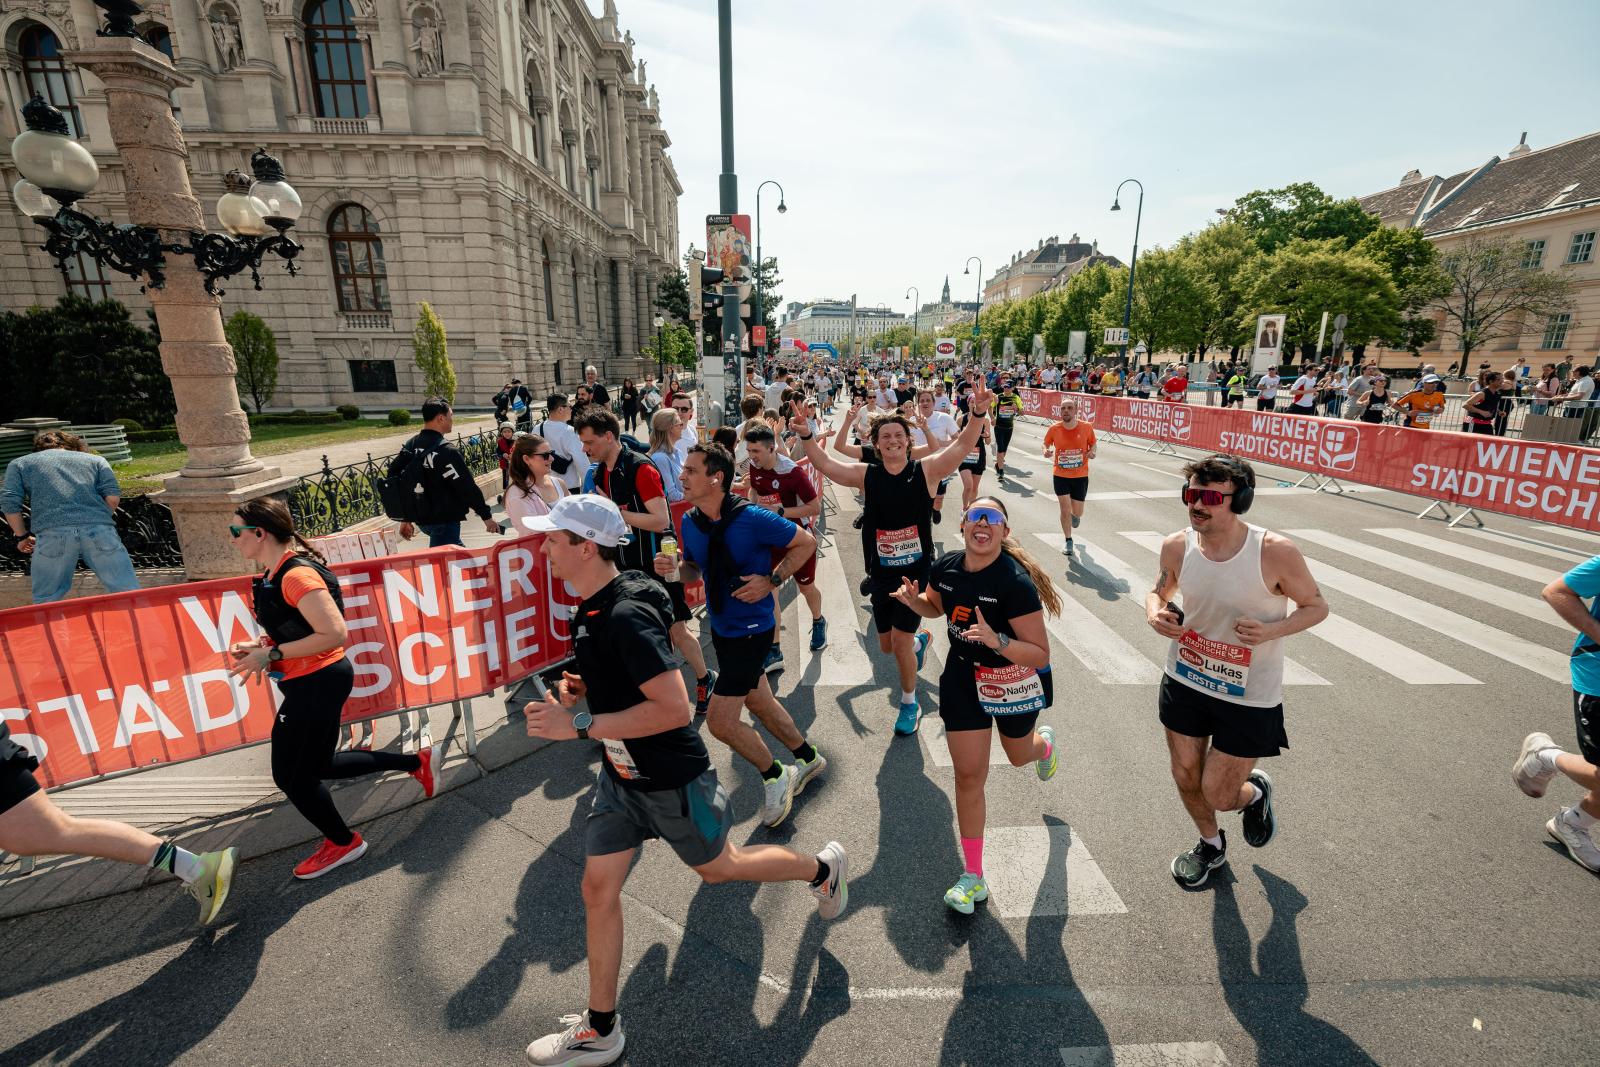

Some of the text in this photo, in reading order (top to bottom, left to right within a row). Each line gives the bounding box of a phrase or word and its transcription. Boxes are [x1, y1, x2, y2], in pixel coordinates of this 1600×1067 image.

[1130, 401, 1170, 419] WIENER
[1112, 415, 1169, 437] STÄDTISCHE
[1252, 414, 1319, 441] WIENER
[1220, 431, 1316, 465] STÄDTISCHE
[1411, 463, 1600, 522] STÄDTISCH
[888, 558, 907, 566] ERSTE
[178, 548, 537, 653] WENER
[1185, 637, 1227, 657] STÄDTISCHE
[1198, 636, 1228, 650] WIENER
[981, 671, 1021, 681] STÄDTISCHE
[993, 665, 1019, 675] WIENER
[1205, 660, 1243, 679] Lukas
[0, 606, 539, 763] STÄDSCHE
[1006, 682, 1039, 695] Nadyne
[1187, 671, 1217, 690] ERSTE
[984, 703, 1034, 714] SPARKASSE
